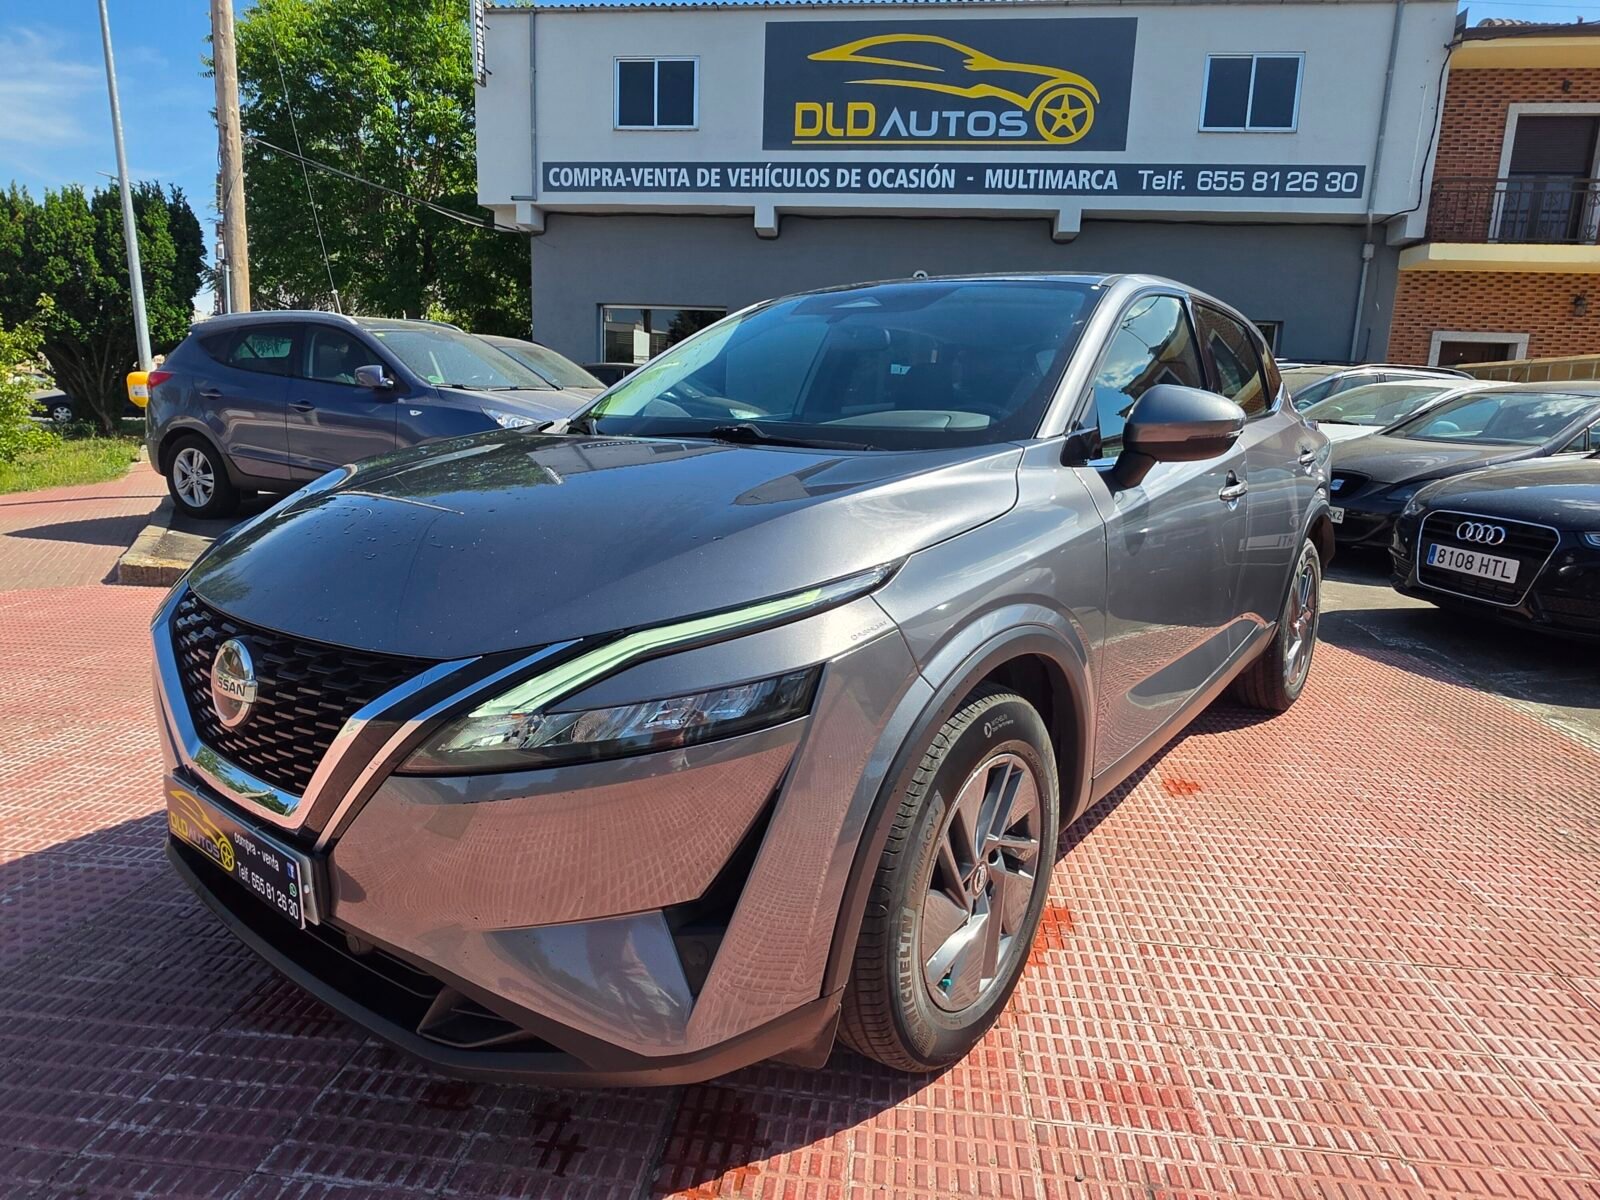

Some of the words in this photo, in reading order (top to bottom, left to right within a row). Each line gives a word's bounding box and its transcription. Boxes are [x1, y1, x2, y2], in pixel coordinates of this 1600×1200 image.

[794, 102, 876, 137] DLD
[880, 110, 1028, 137] AUTOS
[548, 167, 691, 187] COMPRA-VENTA
[696, 168, 721, 187] DE
[727, 162, 830, 188] VEHÍCULOS
[836, 168, 862, 188] DE
[867, 163, 956, 189] OCASIÓN
[984, 168, 1119, 190] MULTIMARCA
[1138, 170, 1186, 190] Telf.
[1196, 170, 1245, 192] 655
[1251, 170, 1280, 192] 81
[1285, 171, 1319, 192] 26
[1324, 171, 1358, 193] 30
[1437, 548, 1475, 571] 8108
[1478, 557, 1511, 580] HTL
[170, 811, 188, 836] DLD
[188, 825, 220, 859] AUTOS
[234, 832, 257, 856] compra
[261, 850, 280, 872] venta
[251, 871, 266, 896] 655
[266, 882, 276, 903] 81
[276, 890, 288, 912] 26
[288, 898, 299, 920] 30
[898, 914, 921, 1030] MICHELIN
